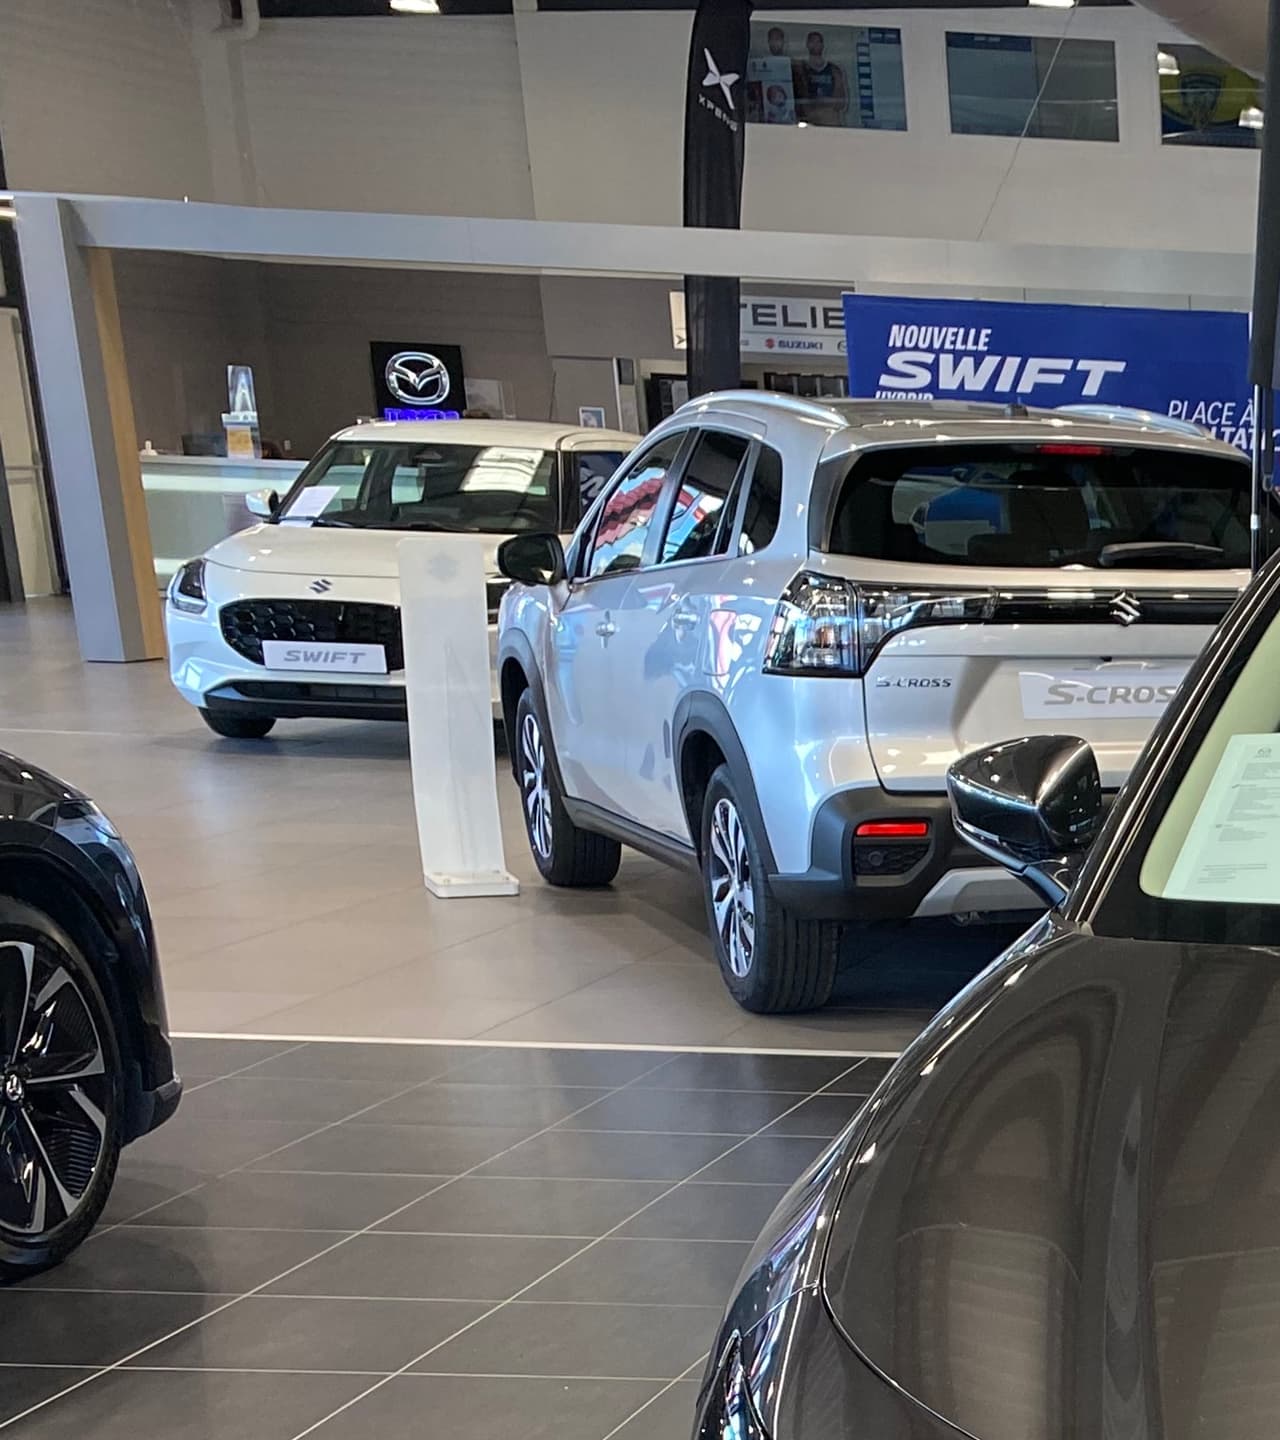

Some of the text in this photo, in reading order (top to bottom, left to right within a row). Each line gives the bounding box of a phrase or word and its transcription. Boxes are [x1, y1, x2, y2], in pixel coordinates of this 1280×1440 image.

[778, 340, 824, 351] SUZUKI
[888, 325, 992, 351] NOUVELLE
[878, 351, 1127, 397] SWIFT
[283, 649, 367, 665] SWIFT
[876, 677, 953, 689] S-CROSS
